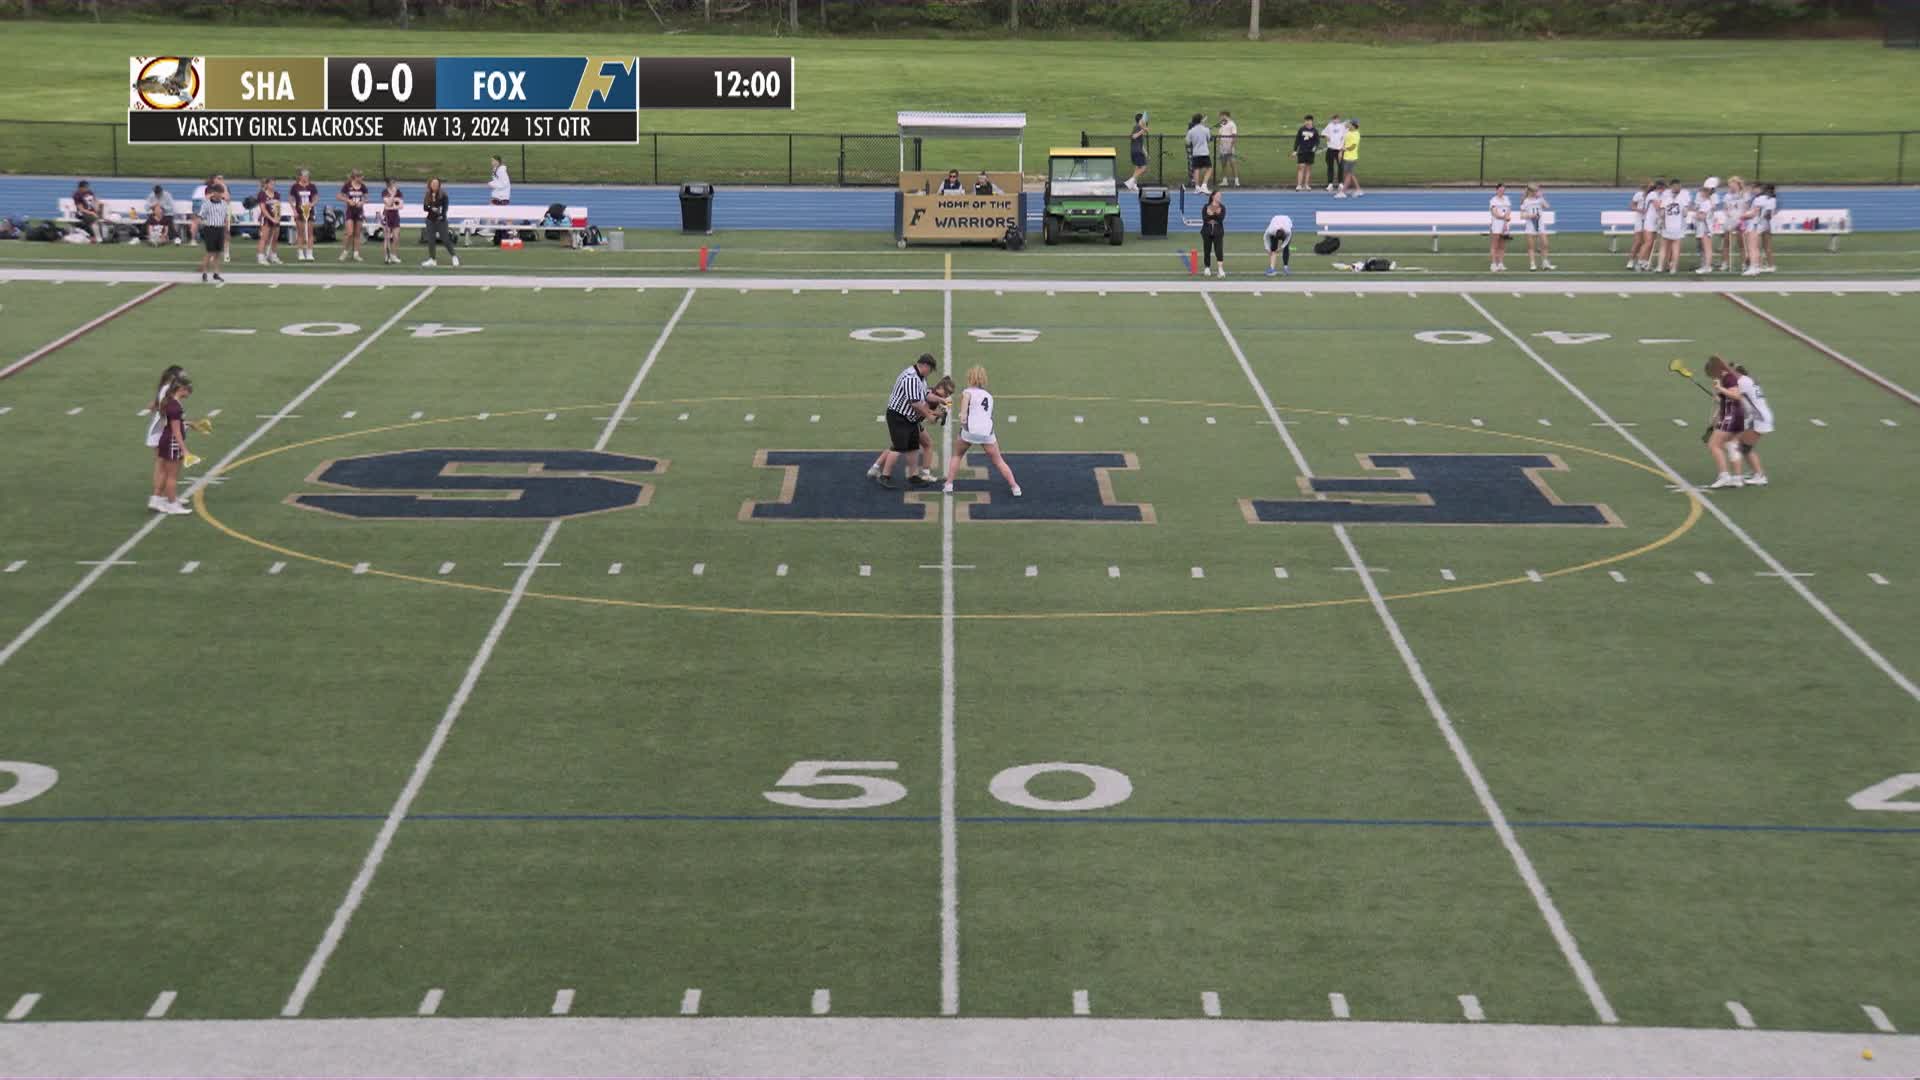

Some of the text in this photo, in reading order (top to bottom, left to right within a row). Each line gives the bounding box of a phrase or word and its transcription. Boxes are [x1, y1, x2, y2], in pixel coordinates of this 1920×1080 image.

[938, 200, 1012, 209] HOME OF THE
[935, 216, 1016, 229] WARRIORS
[980, 396, 989, 412] 4
